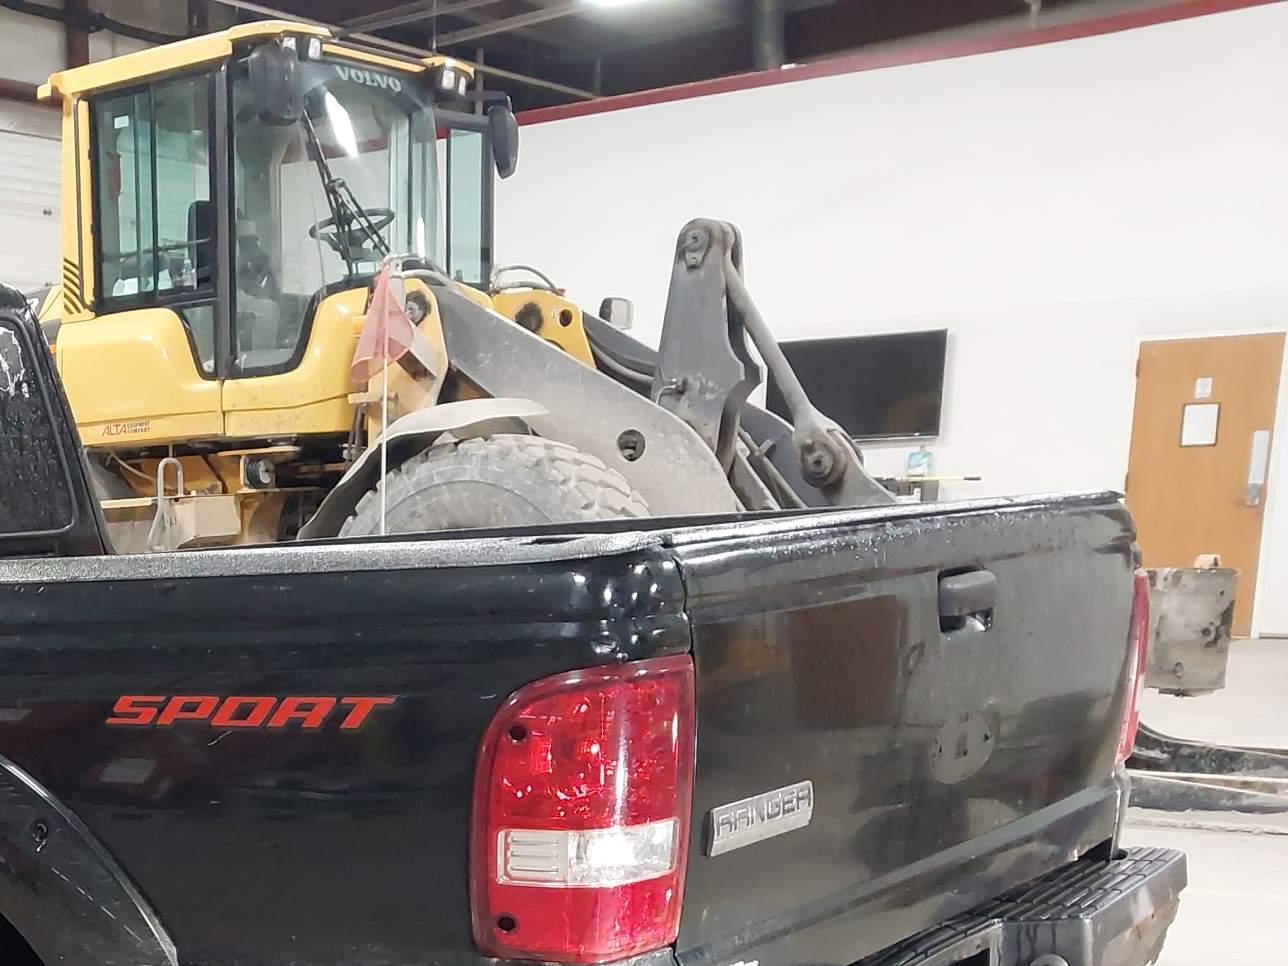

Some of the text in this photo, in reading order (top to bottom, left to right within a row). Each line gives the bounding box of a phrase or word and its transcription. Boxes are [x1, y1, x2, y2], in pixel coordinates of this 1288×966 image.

[334, 64, 402, 92] VOLVO
[101, 422, 127, 437] ALTA
[106, 695, 396, 729] SPORT
[715, 787, 810, 837] RANGER
